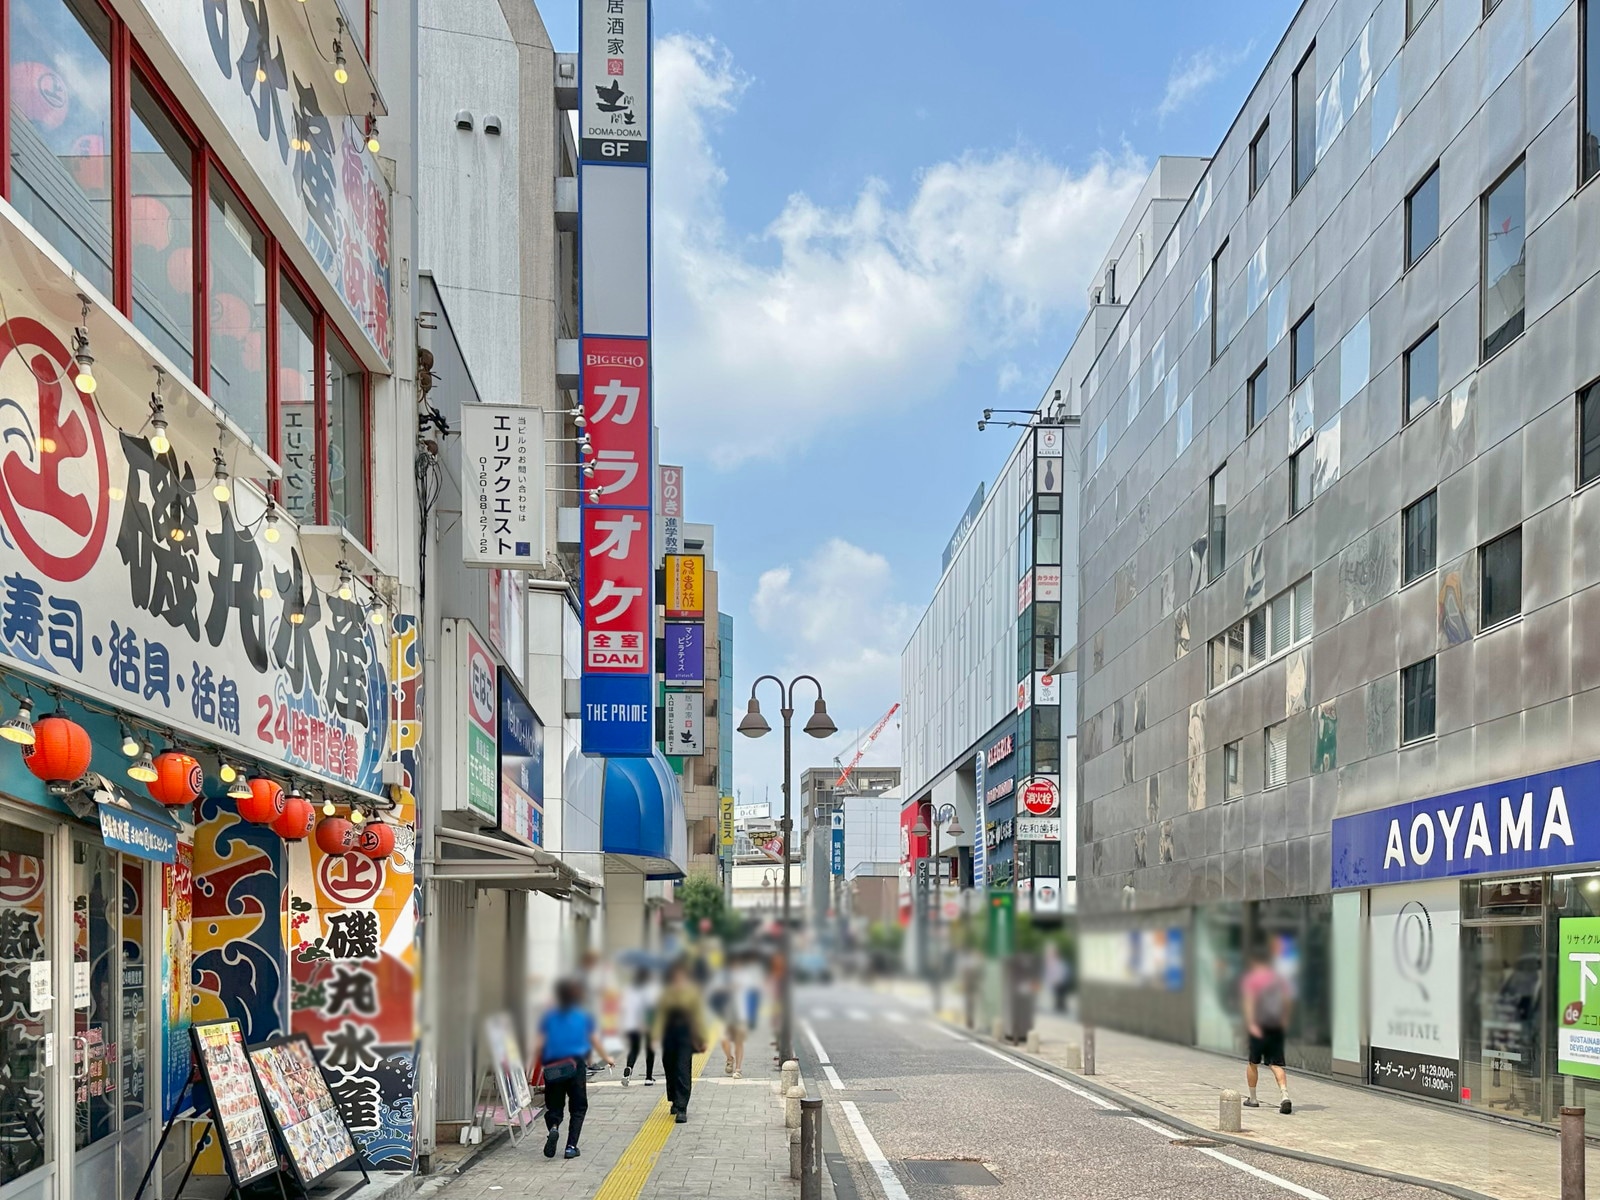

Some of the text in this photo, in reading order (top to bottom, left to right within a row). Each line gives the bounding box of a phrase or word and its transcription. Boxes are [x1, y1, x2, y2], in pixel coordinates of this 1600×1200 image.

[589, 127, 642, 137] DOMA-DOMA
[601, 142, 630, 157] 6F
[586, 354, 644, 368] BIG ECHO
[494, 416, 512, 555] エリアクエスト
[518, 417, 526, 522] 当ビルのお問い合わせは
[479, 456, 488, 554] 0120-88-27-22
[590, 379, 643, 624] カラオケ
[664, 470, 678, 515] ひのき
[116, 427, 368, 729] 磯丸水産
[592, 653, 639, 665] DAM
[593, 633, 638, 649] 全室
[473, 659, 493, 713] たばこ
[586, 703, 648, 723] THE PRIME
[257, 694, 360, 782] 24時間営業
[1027, 792, 1052, 804] 消火栓
[724, 802, 732, 838] プロミス
[1020, 824, 1059, 833] 佐和歯科
[1383, 786, 1574, 869] AOYAMA
[325, 909, 380, 1131] 磯丸水産
[1565, 1009, 1579, 1021] de
[1375, 1060, 1417, 1080] オーダースーツ
